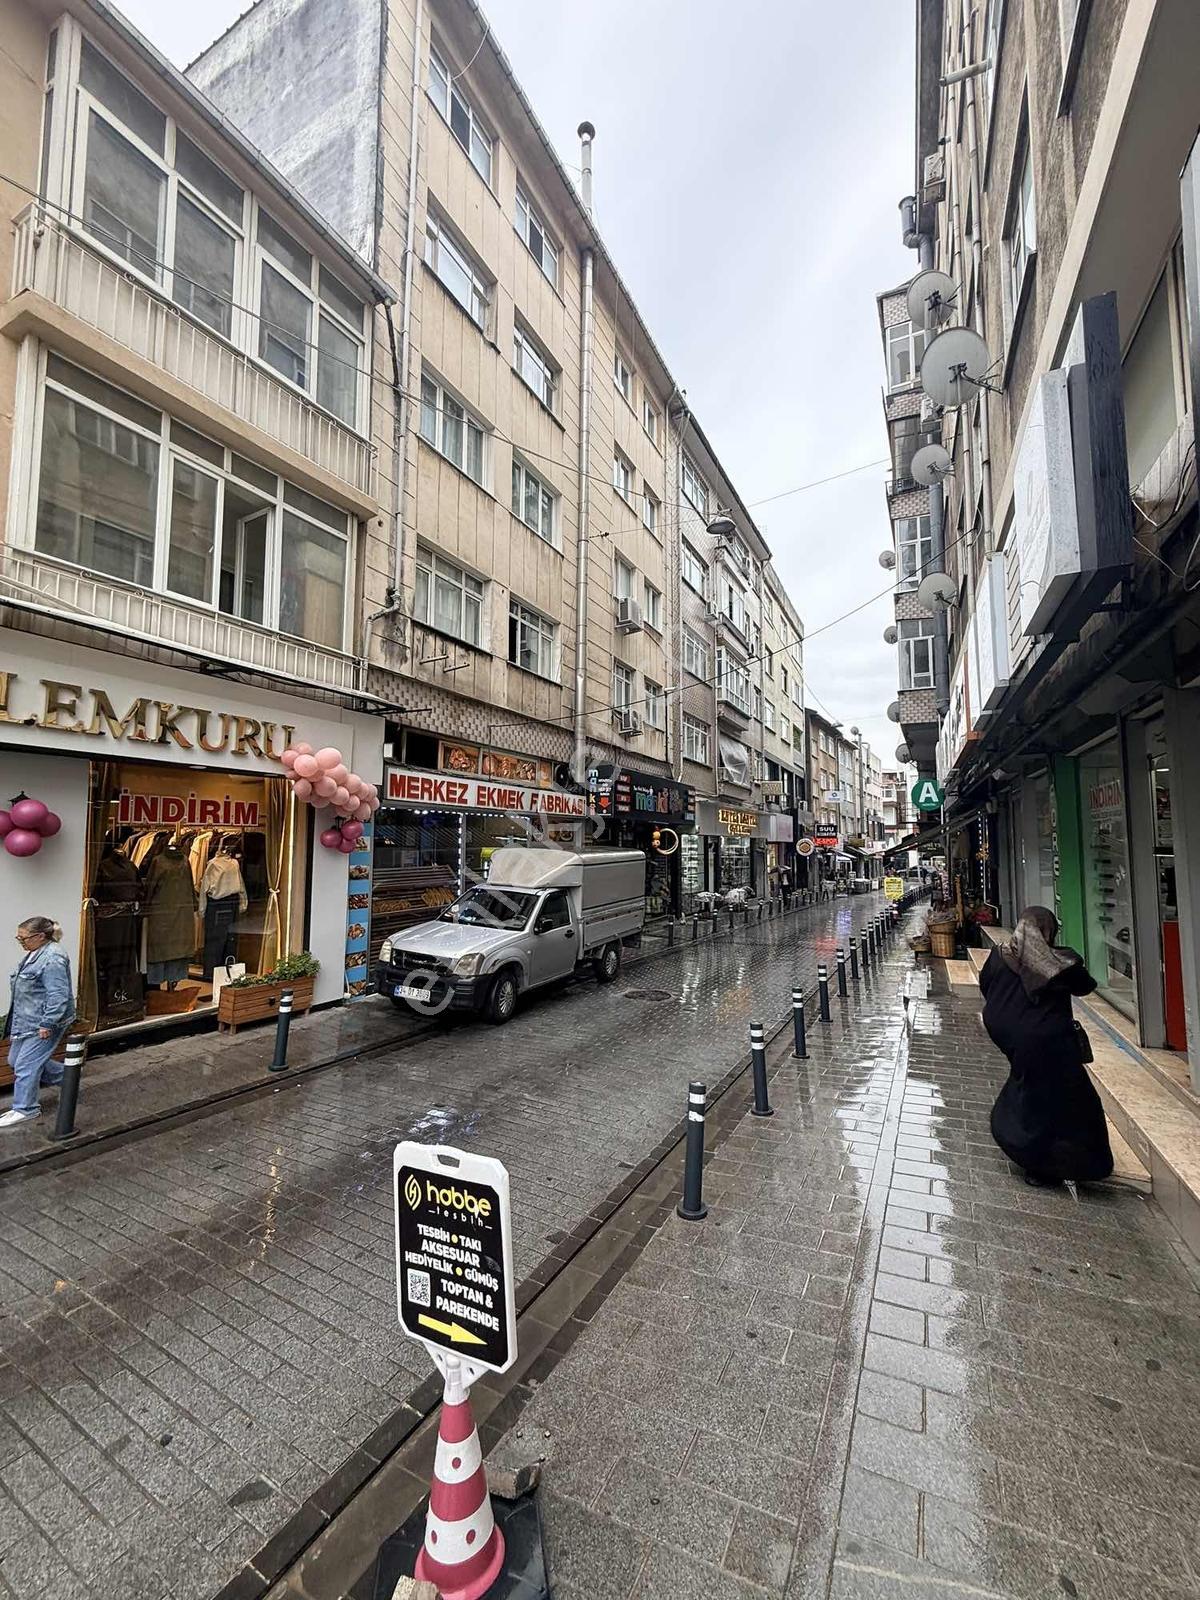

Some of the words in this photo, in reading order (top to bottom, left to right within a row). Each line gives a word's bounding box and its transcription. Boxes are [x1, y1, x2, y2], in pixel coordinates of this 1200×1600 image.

[117, 787, 259, 827] İNDİRİM
[389, 774, 469, 804] MERKEZ
[477, 785, 524, 810] EKMEK
[918, 782, 939, 803] A
[427, 1180, 492, 1217] habbe
[417, 1224, 450, 1243] TESBİH
[459, 1235, 482, 1252] TAKI
[421, 1239, 480, 1268] AKSESUAR
[405, 1251, 454, 1275] HEDİYELİK
[464, 1268, 499, 1292] GÜMÜŞ
[440, 1279, 484, 1305] TOPTAN
[485, 1294, 494, 1309] &
[436, 1296, 500, 1332] PAREKENDE
